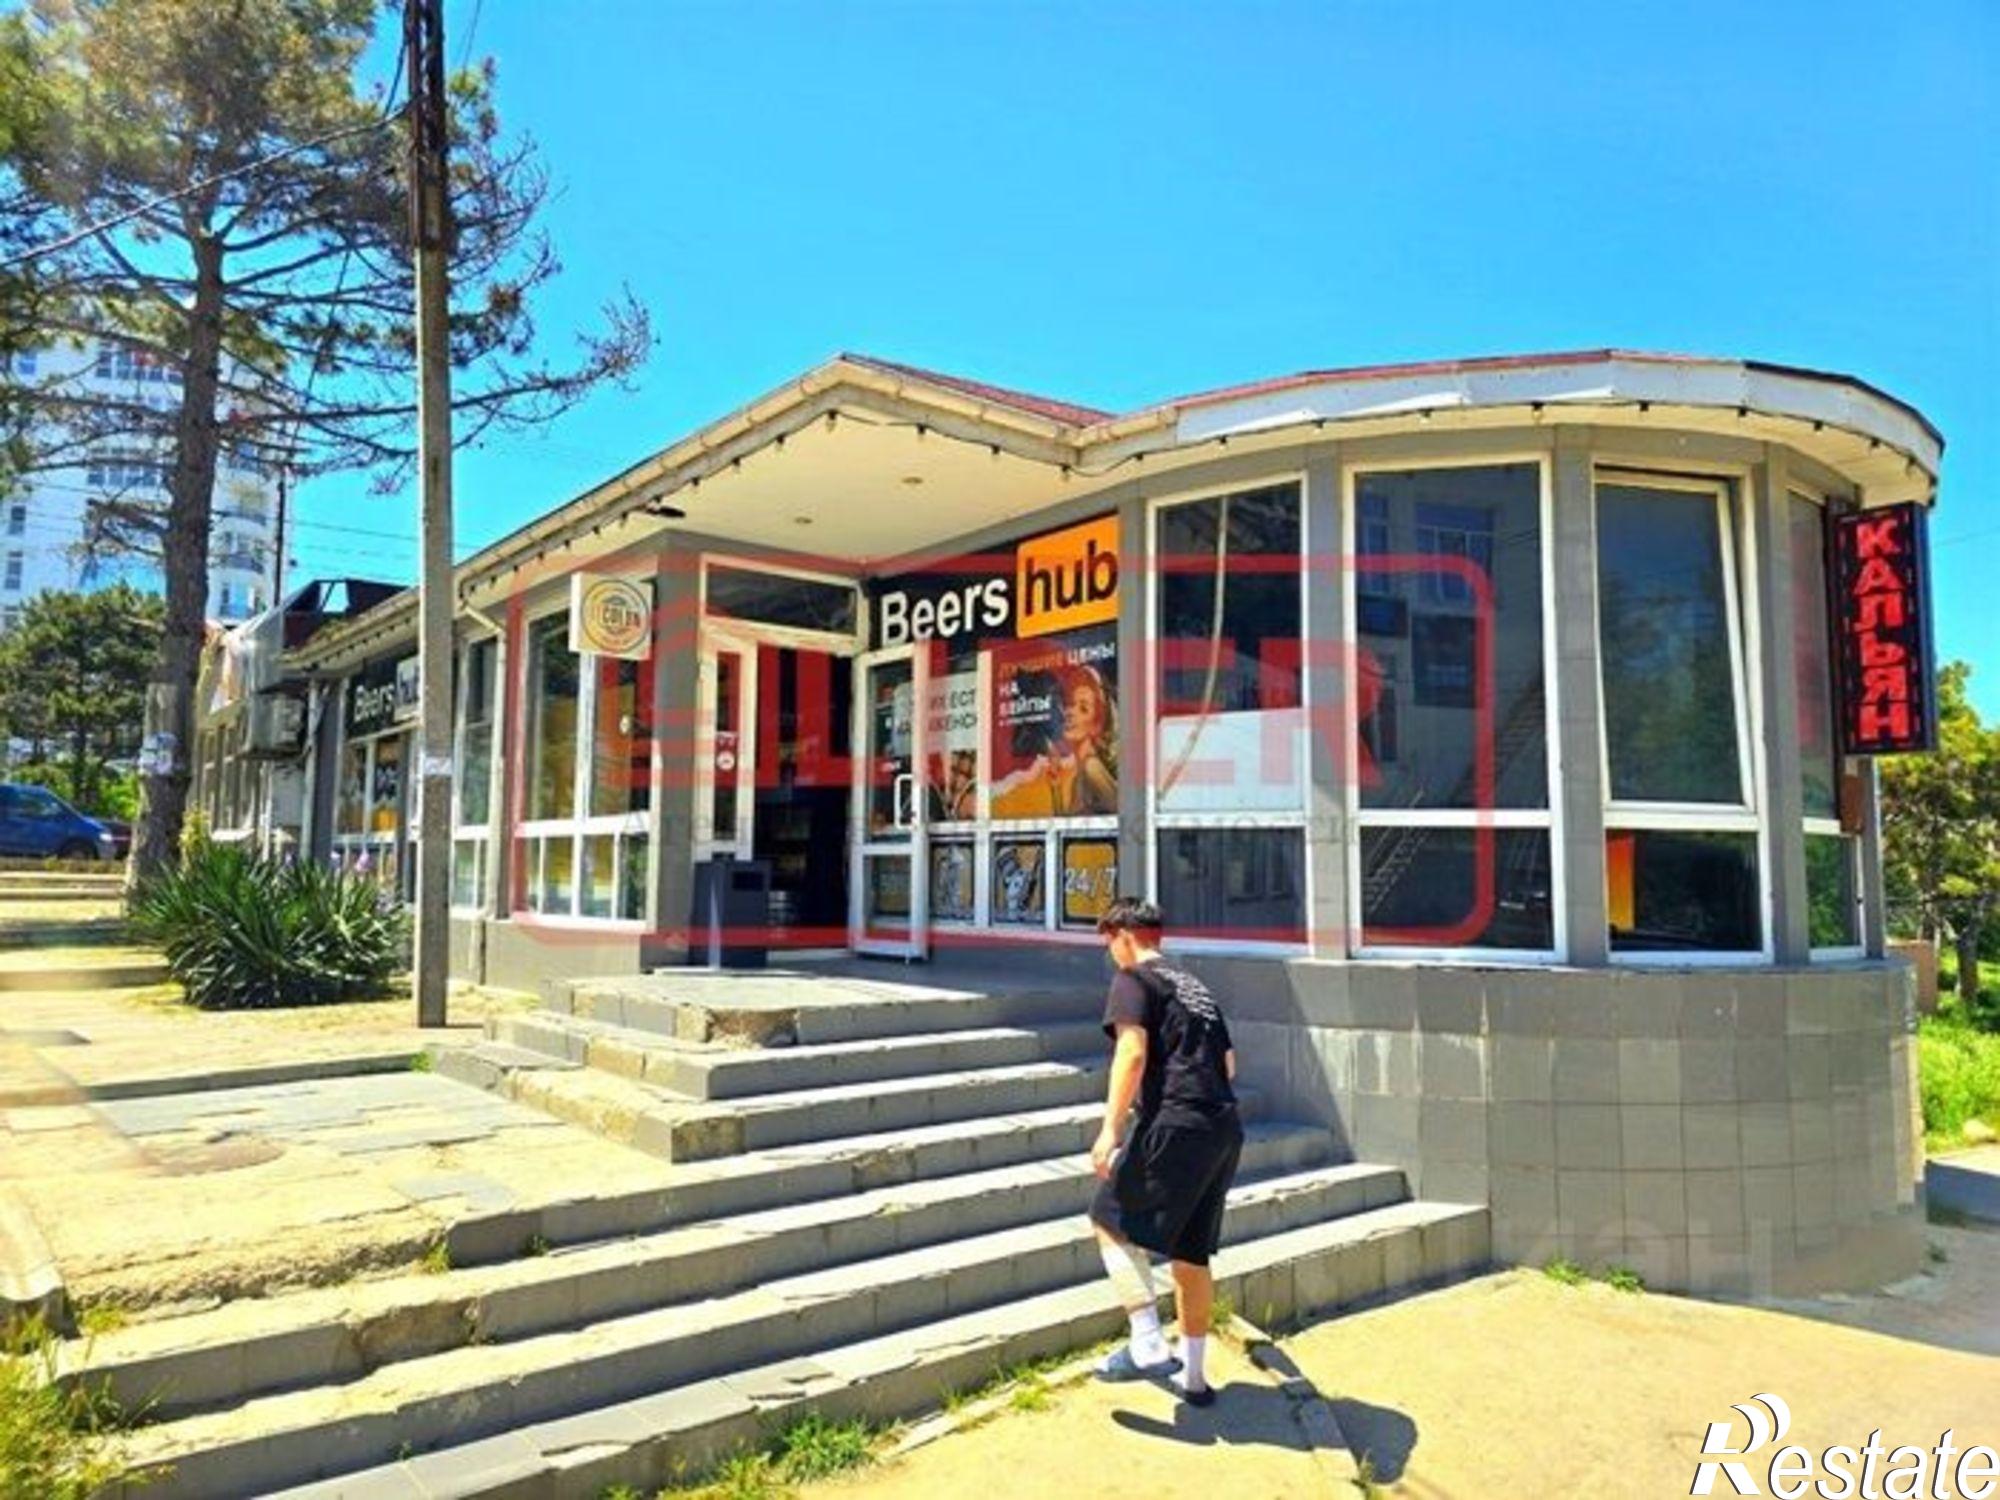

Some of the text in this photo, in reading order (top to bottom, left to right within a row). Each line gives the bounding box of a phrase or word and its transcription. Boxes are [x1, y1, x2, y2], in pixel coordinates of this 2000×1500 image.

[881, 540, 1117, 646] Beers hub
[1854, 518, 1911, 742] КАЛЬЯН
[1064, 867, 1117, 897] 24/7
